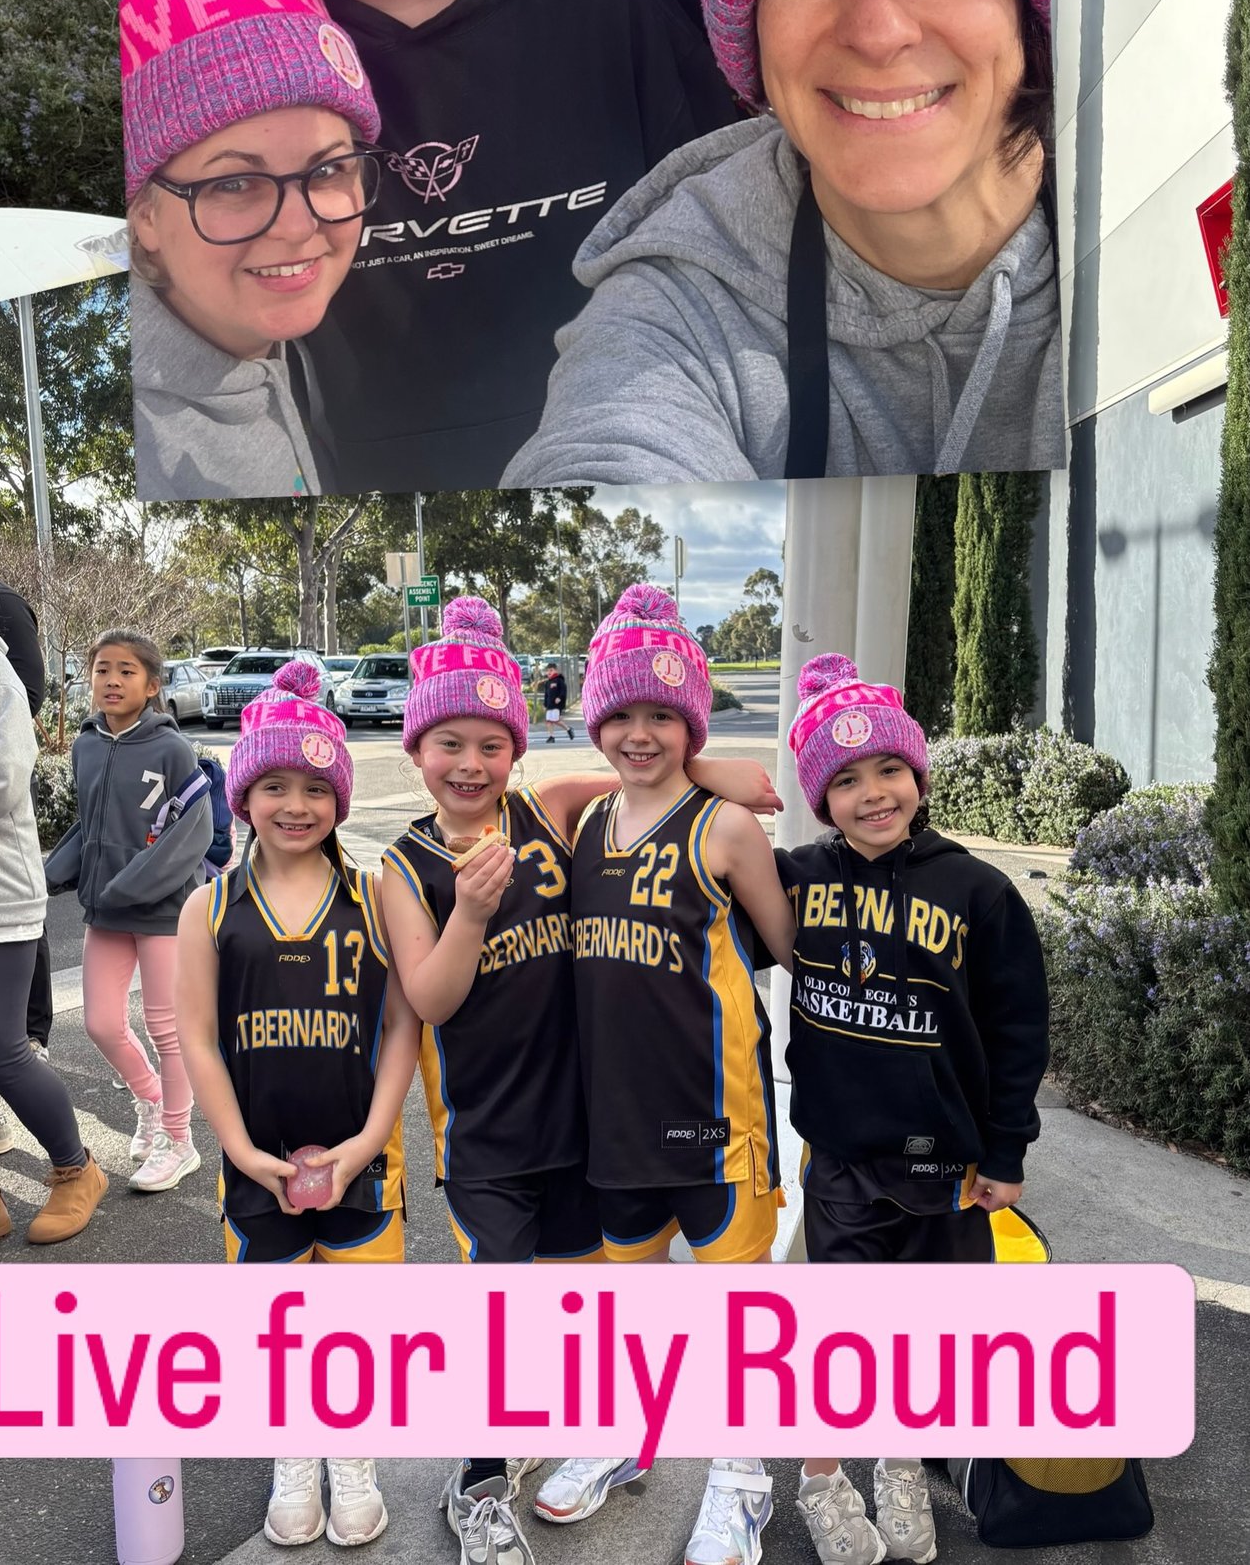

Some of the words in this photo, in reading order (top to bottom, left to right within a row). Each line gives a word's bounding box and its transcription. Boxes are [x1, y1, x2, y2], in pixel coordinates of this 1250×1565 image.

[360, 181, 607, 247] RVETTE
[367, 256, 386, 267] JUST
[387, 256, 394, 264] A
[414, 250, 424, 260] AN
[474, 239, 501, 252] SWEET
[408, 588, 437, 596] ASSEMBLY
[414, 595, 431, 603] POINT
[139, 769, 166, 810] 7
[517, 837, 568, 899] 3
[629, 841, 680, 908] 22
[787, 885, 800, 928] T
[323, 929, 365, 996] 13
[576, 916, 683, 974] BERNARD'S
[804, 975, 827, 991] OLD
[702, 1127, 726, 1140] 2XS
